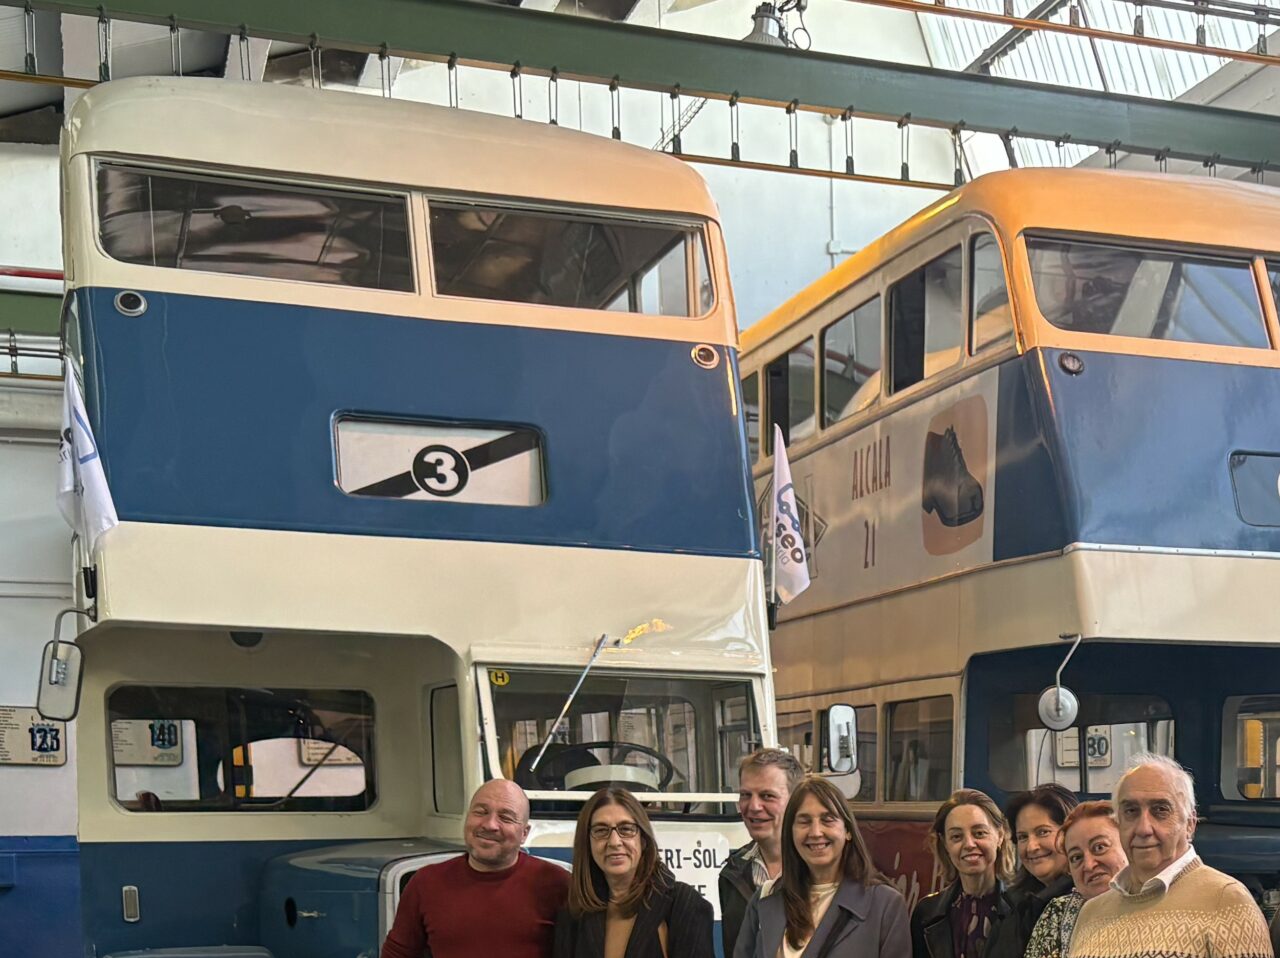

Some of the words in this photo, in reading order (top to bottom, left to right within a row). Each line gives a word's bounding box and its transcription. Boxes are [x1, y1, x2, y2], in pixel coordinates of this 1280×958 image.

[423, 450, 460, 492] 3
[851, 435, 891, 501] ALCALA
[776, 516, 804, 565] seo
[863, 519, 877, 569] 21
[28, 727, 60, 752] 123
[148, 722, 178, 747] 140
